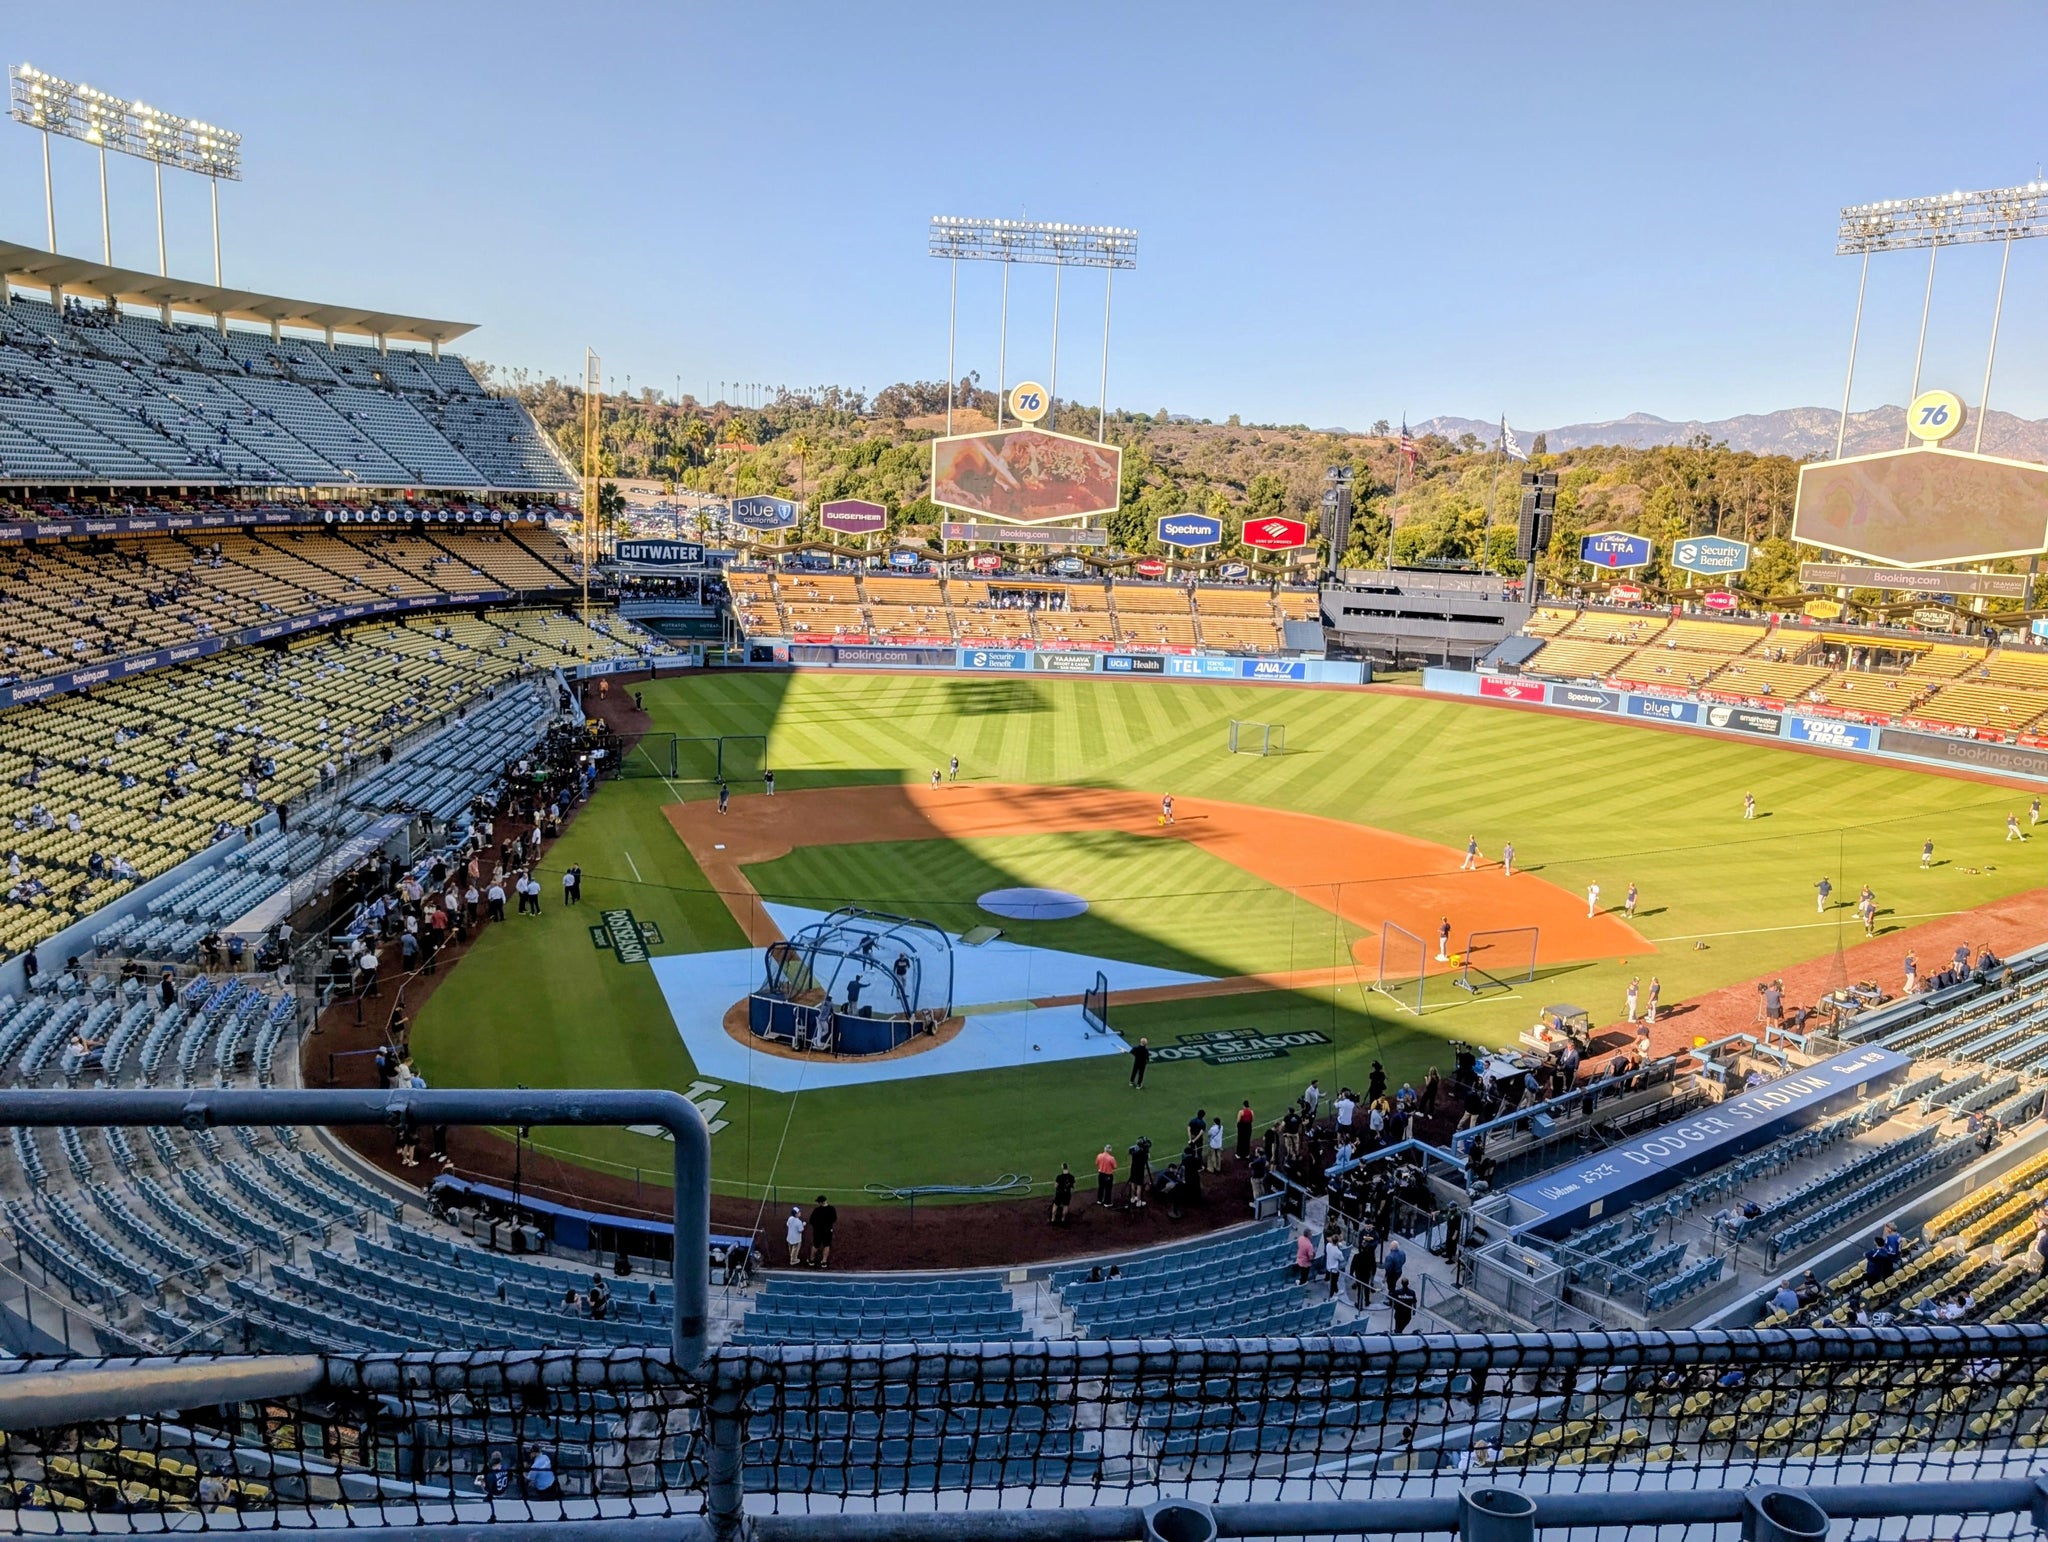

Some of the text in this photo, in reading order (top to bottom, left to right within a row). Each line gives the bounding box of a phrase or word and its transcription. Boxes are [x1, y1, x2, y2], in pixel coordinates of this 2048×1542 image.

[1020, 393, 1040, 410] 76
[1920, 404, 1948, 425] 76
[738, 502, 774, 517] blue
[827, 513, 881, 521] GUGGENHEIM
[37, 524, 72, 535] Booking.com
[86, 522, 117, 532] Booking.com
[1165, 524, 1211, 535] Spectrum
[1000, 530, 1050, 540] Booking.com
[621, 545, 698, 560] CUTWATER
[1595, 542, 1634, 553] ULTRA
[1700, 545, 1741, 560] Security
[1700, 556, 1734, 567] Benefit
[1874, 572, 1941, 586] Booking.com
[1611, 588, 1640, 599] Churu
[1916, 611, 1950, 620] STARLUX
[170, 647, 199, 660] Booking.com
[838, 649, 908, 662] Booking.com
[989, 653, 1015, 662] Security
[125, 657, 157, 672] Booking.com
[1111, 660, 1160, 669] UCLA Health
[1173, 659, 1201, 673] TEL
[1254, 663, 1279, 672] ANA
[72, 669, 109, 685] Booking.com
[12, 682, 54, 700] Booking.com
[1513, 681, 1539, 689] AMERICA
[1567, 691, 1601, 703] Spectrum
[1643, 700, 1670, 714] blue
[1740, 714, 1778, 725] smartwater
[1802, 720, 1846, 735] TOYO
[1808, 732, 1855, 747] TIRES
[1947, 743, 2048, 771] Booking.com
[605, 910, 647, 963] POSTSEASON
[1149, 1032, 1328, 1062] POSTSEASON
[1217, 1051, 1275, 1063] loanDepot
[1622, 1075, 1831, 1165] DODGER STADIUM
